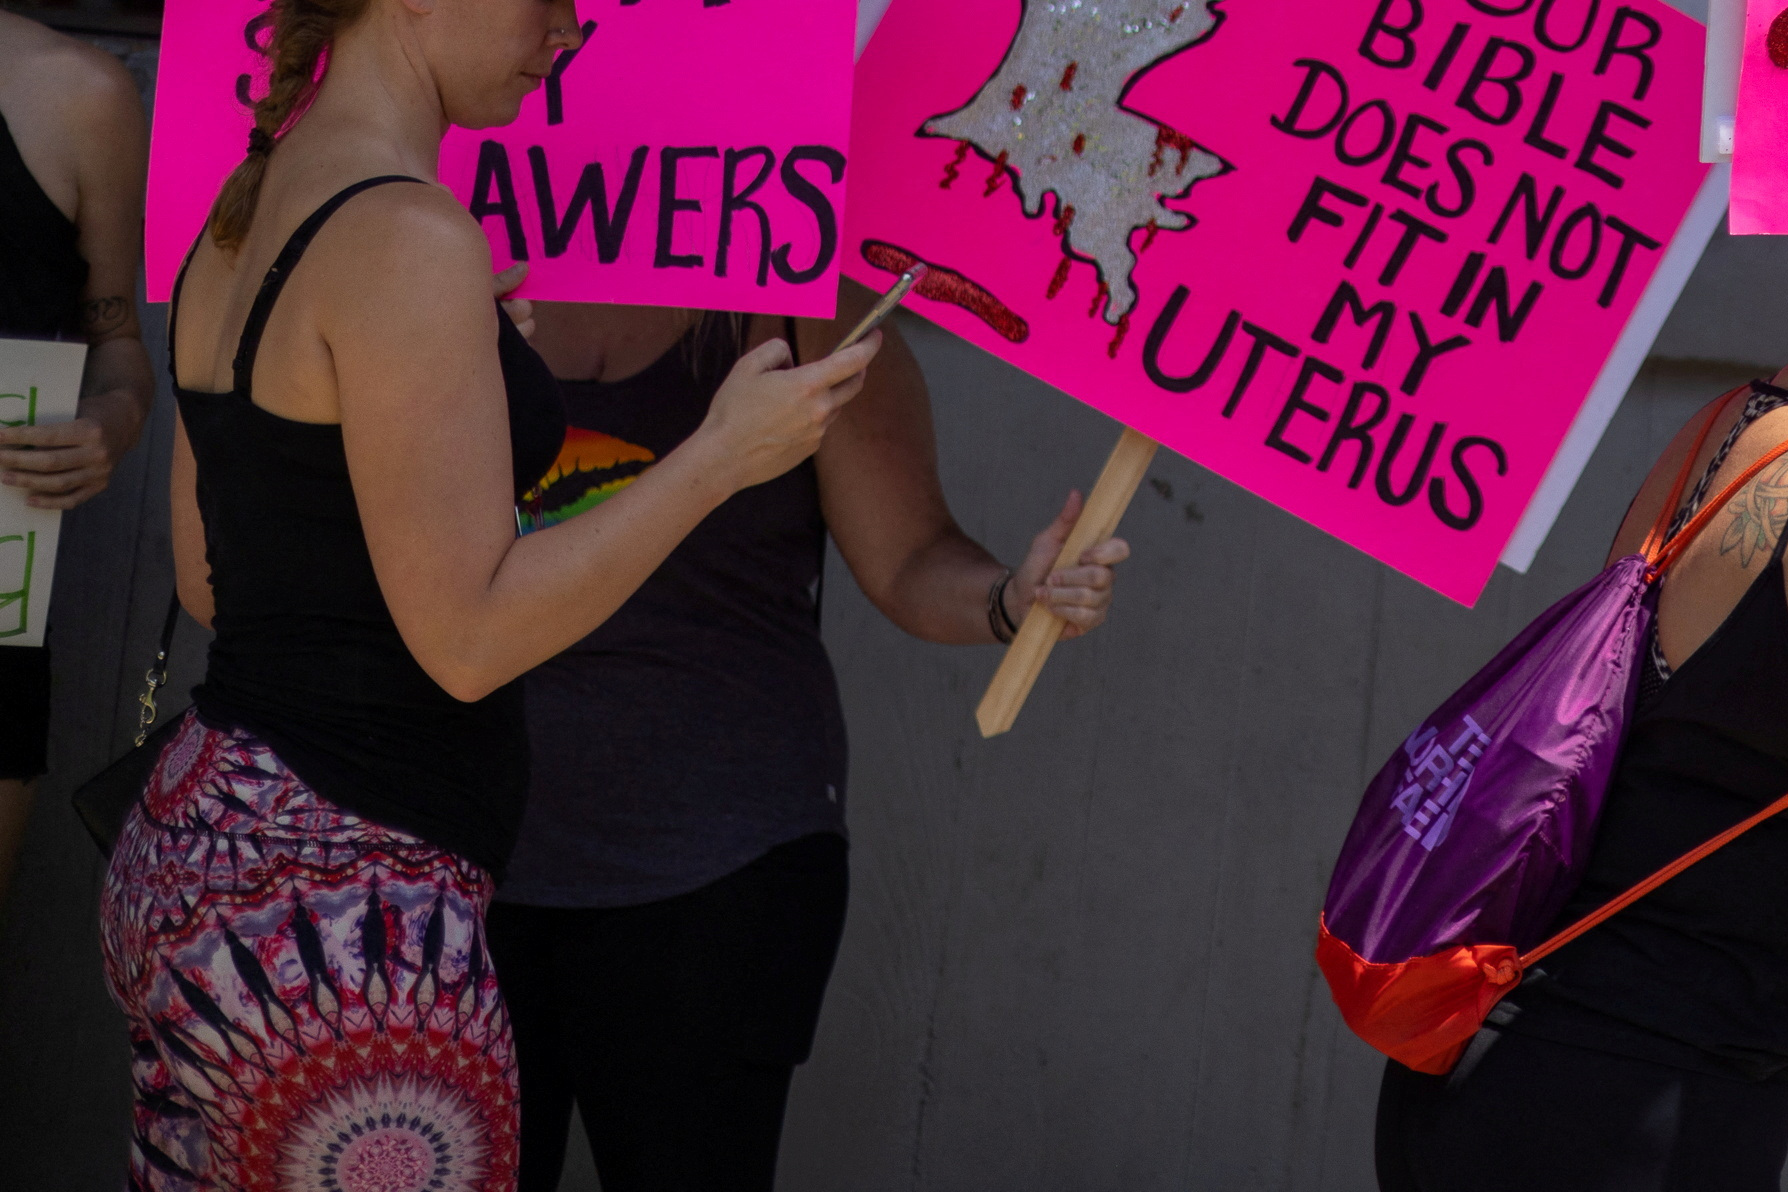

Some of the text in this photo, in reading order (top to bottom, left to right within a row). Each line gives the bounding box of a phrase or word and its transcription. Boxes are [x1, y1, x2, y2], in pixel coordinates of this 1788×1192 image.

[467, 139, 847, 287] AWERS
[1270, 59, 1663, 309] DOES NOT
[1287, 175, 1544, 344] FIT IN
[1141, 285, 1510, 533] UTERUS
[1312, 281, 1474, 398] MY
